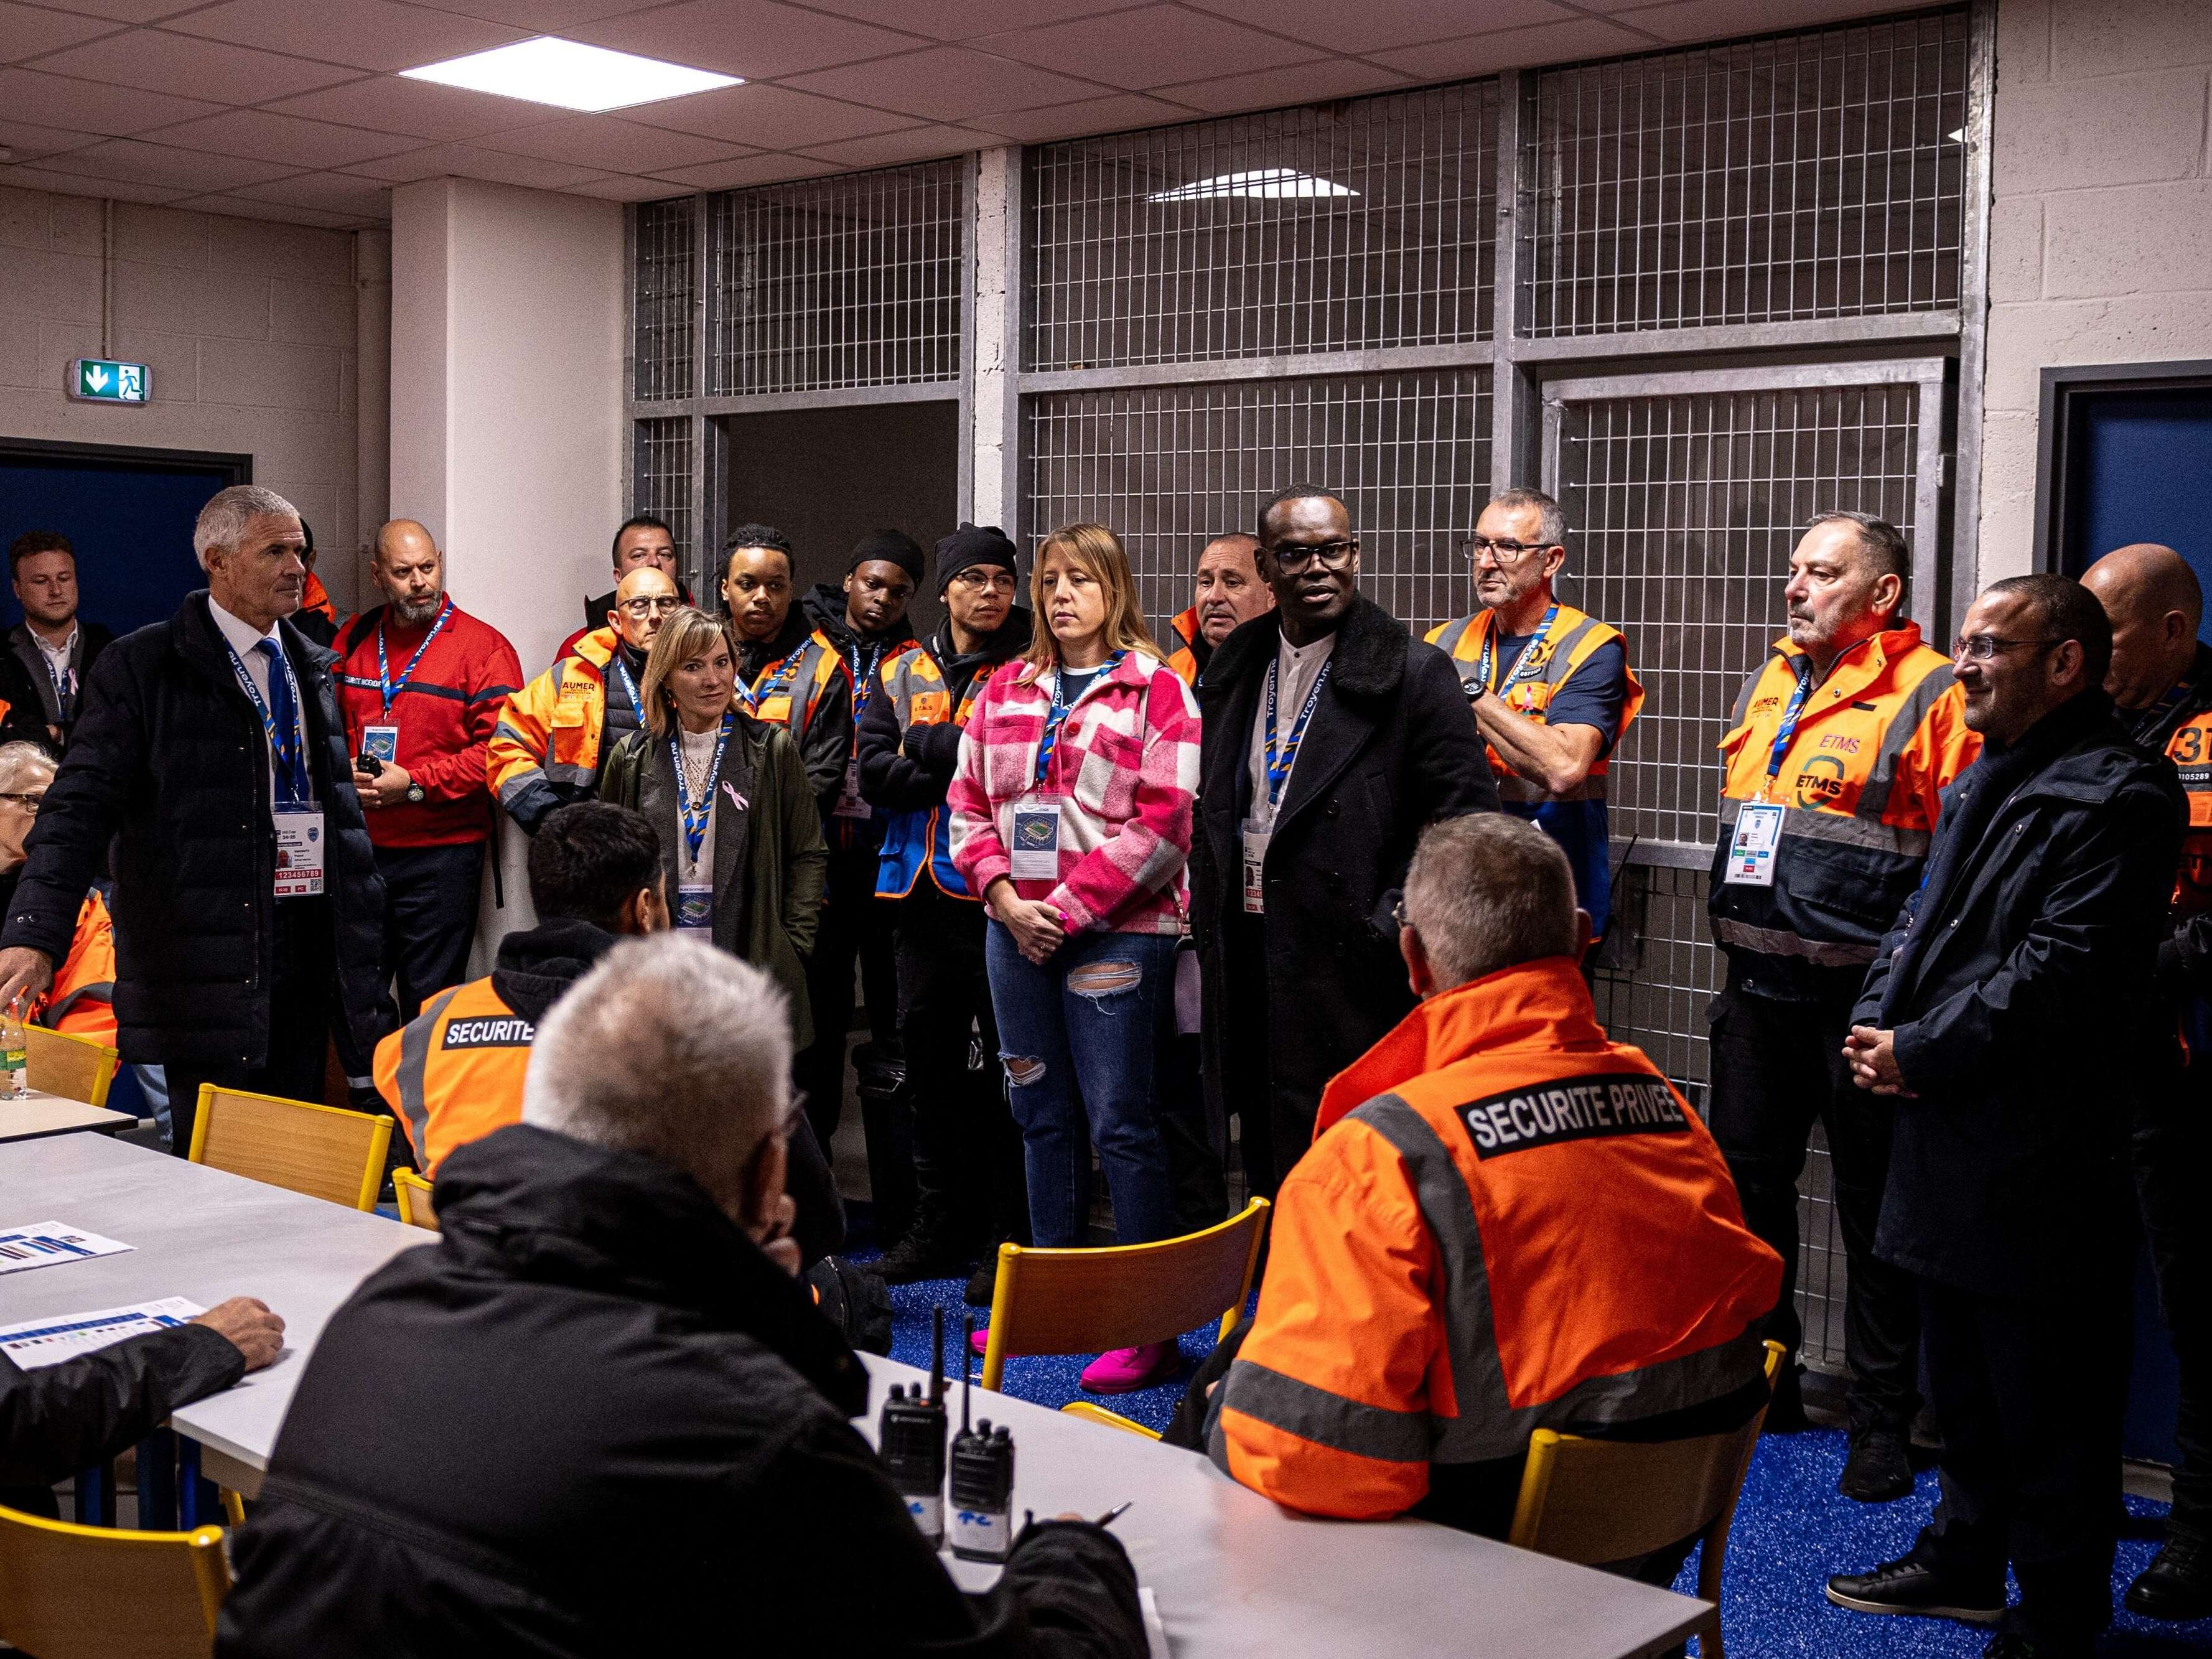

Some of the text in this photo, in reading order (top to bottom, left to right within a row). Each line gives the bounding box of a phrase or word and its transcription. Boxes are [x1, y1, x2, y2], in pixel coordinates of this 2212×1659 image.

[228, 651, 261, 707] Troyen.ne
[562, 682, 595, 691] AUMER
[1266, 658, 1277, 719] Troyen.ne
[1299, 661, 1332, 719] Troyen.ne
[671, 742, 685, 792] Troyen.ne
[706, 743, 725, 792] Troyen.ne
[1819, 734, 1860, 754] ETMS
[1796, 775, 1842, 795] ETMS
[278, 871, 319, 879] 123456789
[447, 1020, 535, 1044] SECURITE
[1467, 1083, 1684, 1148] SECURITE PRIVEE
